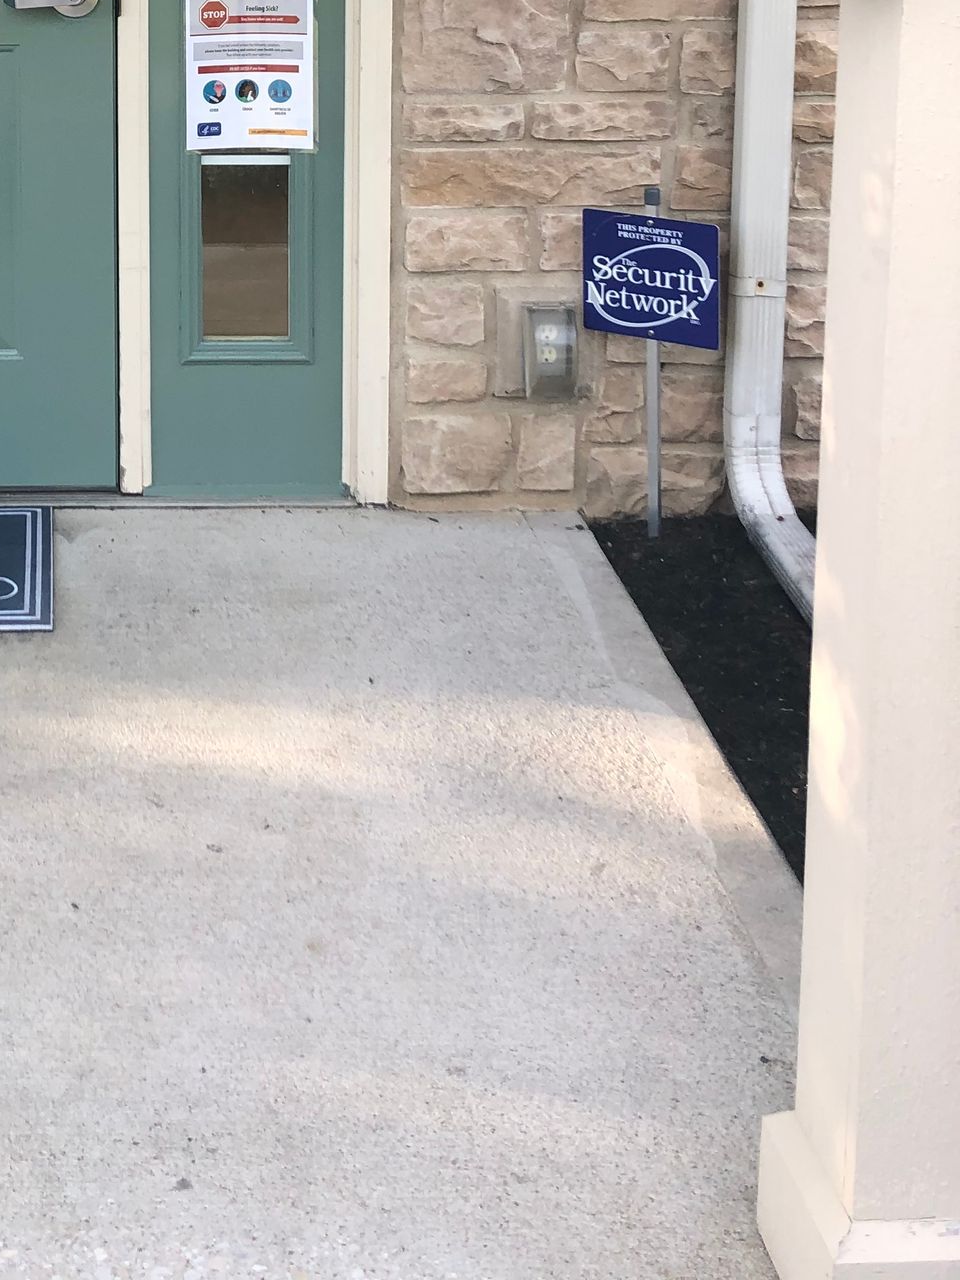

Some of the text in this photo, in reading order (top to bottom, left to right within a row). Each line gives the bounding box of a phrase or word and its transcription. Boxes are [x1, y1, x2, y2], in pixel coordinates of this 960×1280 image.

[203, 11, 226, 19] STOP
[246, 5, 265, 13] Feeling
[616, 223, 683, 238] THIS PROPERTY
[617, 230, 670, 243] PROTECTED
[621, 258, 637, 267] The
[592, 255, 717, 301] Security
[585, 280, 700, 321] Network
